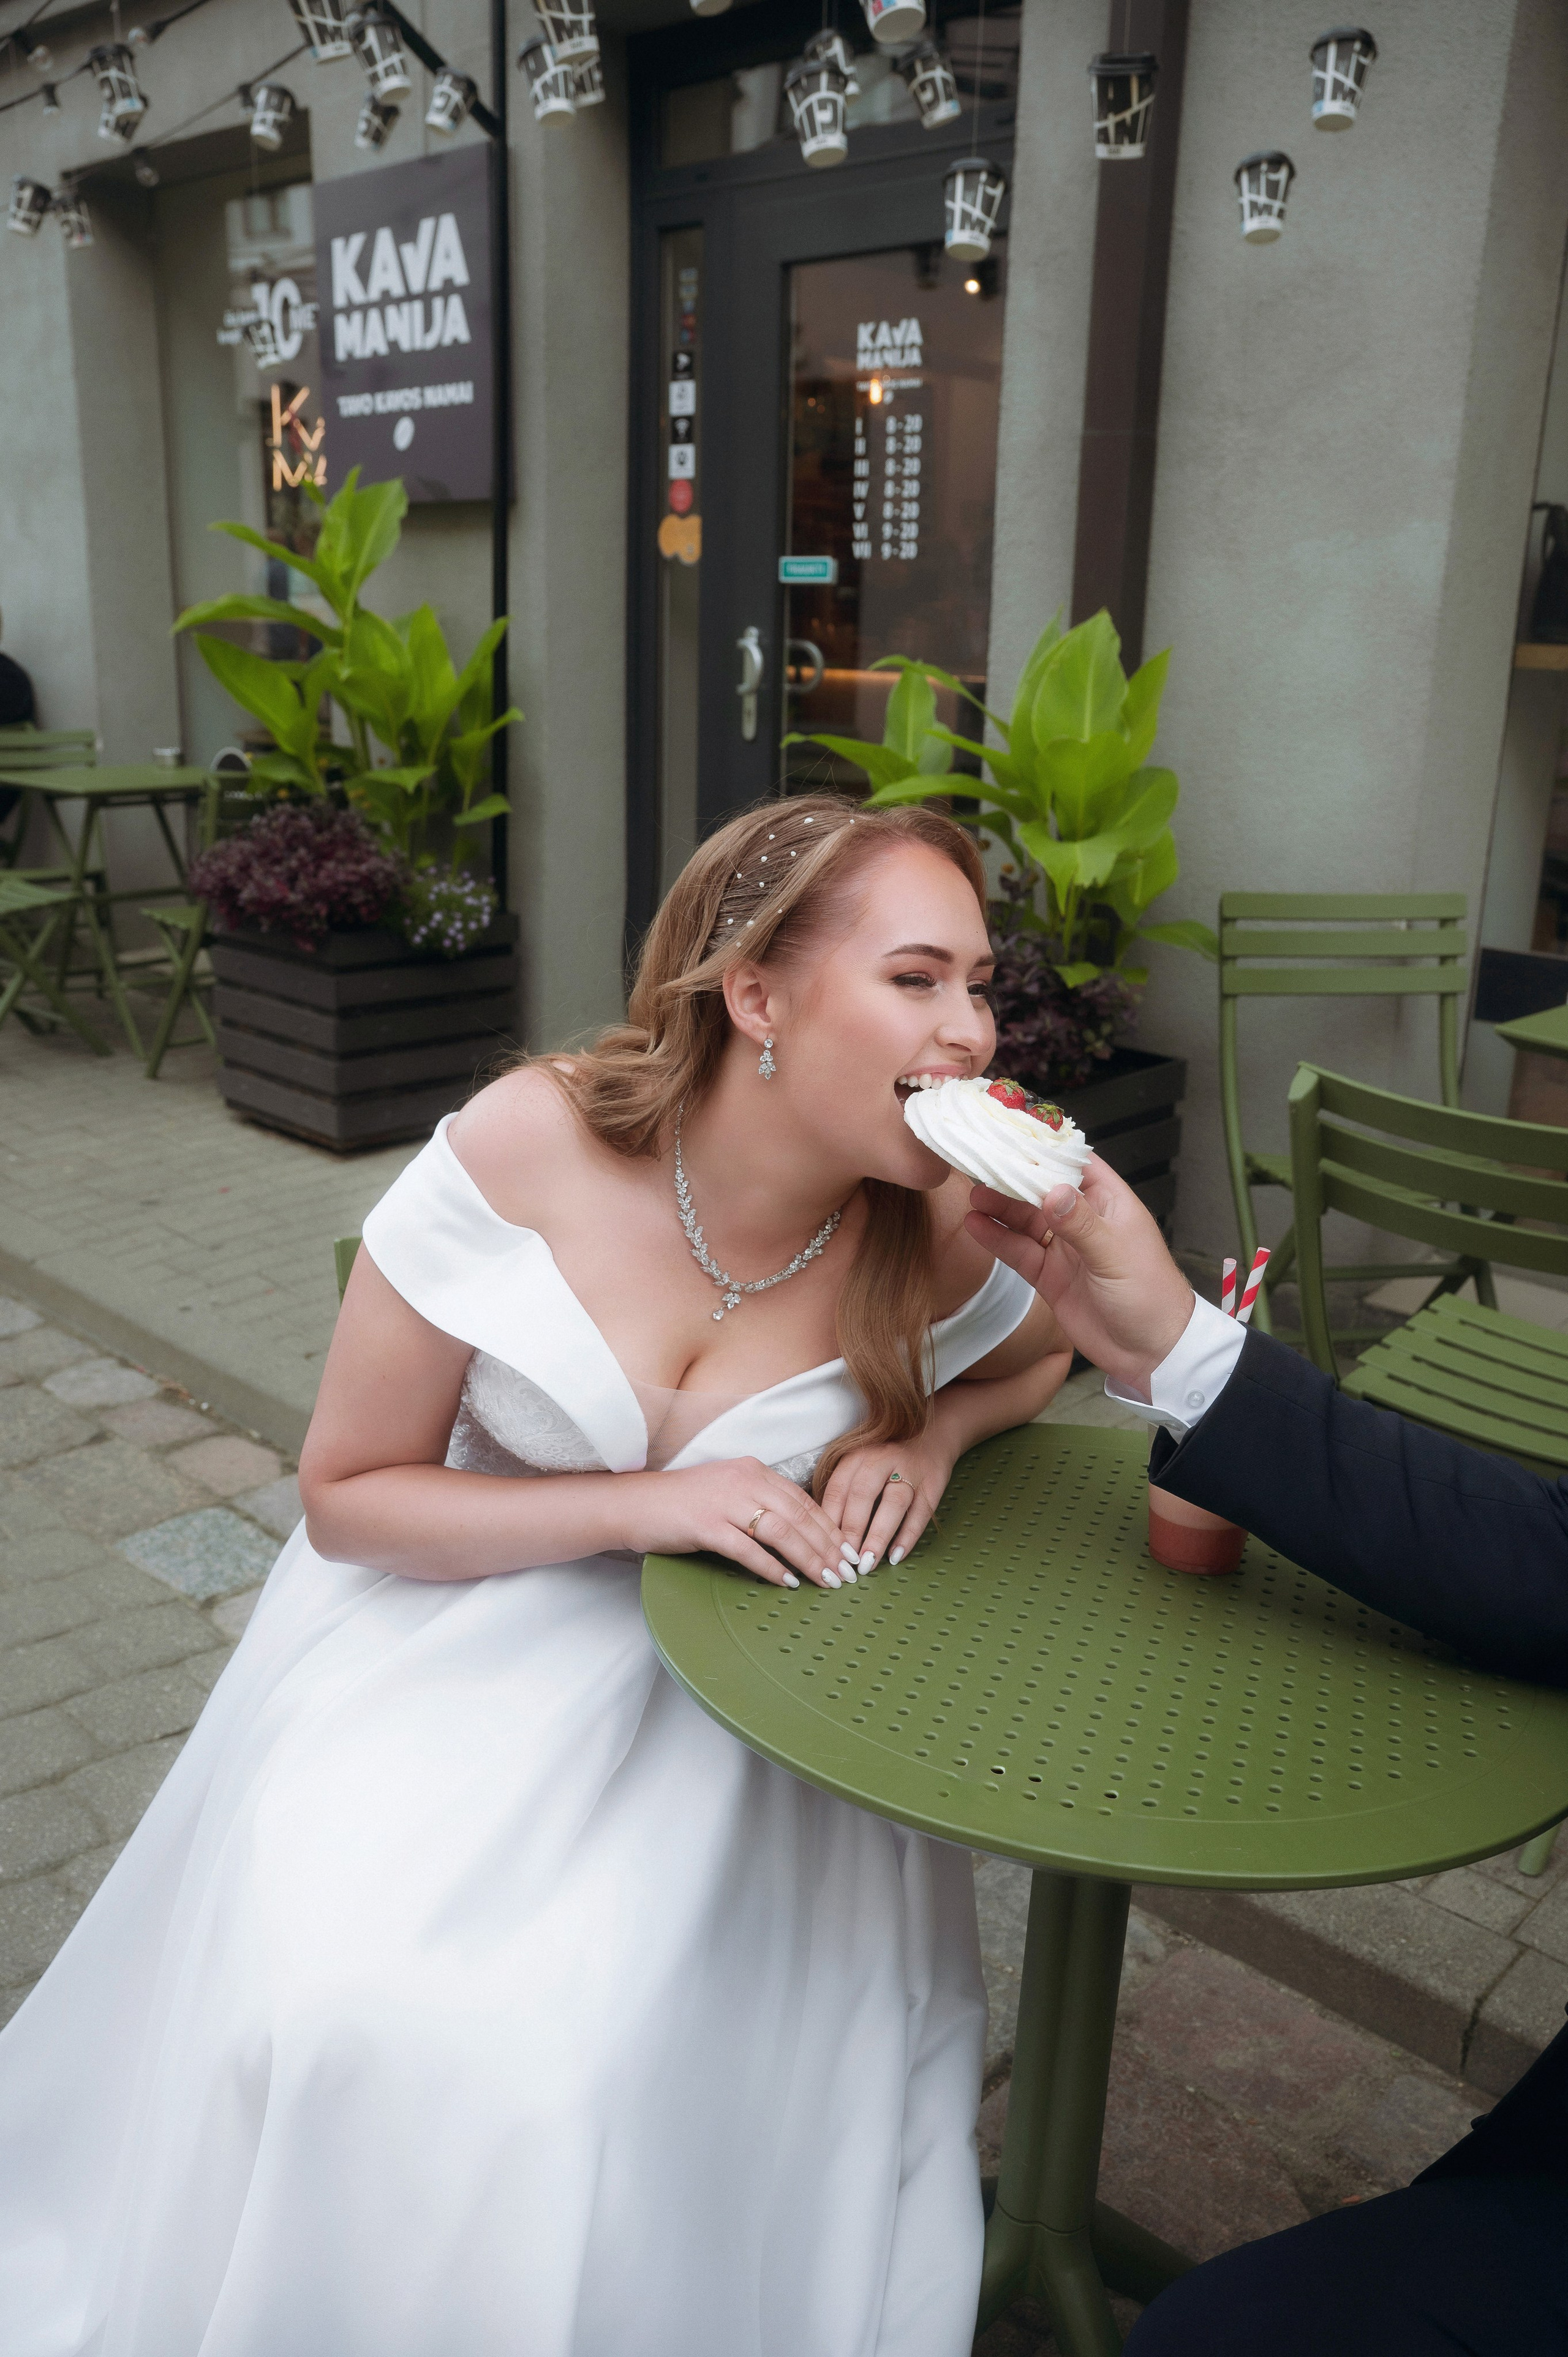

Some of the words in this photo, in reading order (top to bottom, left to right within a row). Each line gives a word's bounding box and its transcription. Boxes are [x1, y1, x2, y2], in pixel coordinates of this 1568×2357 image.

[331, 213, 470, 309] KAVA
[334, 293, 471, 362] MANIJA
[857, 317, 924, 350] KAVA
[853, 502, 865, 520] V
